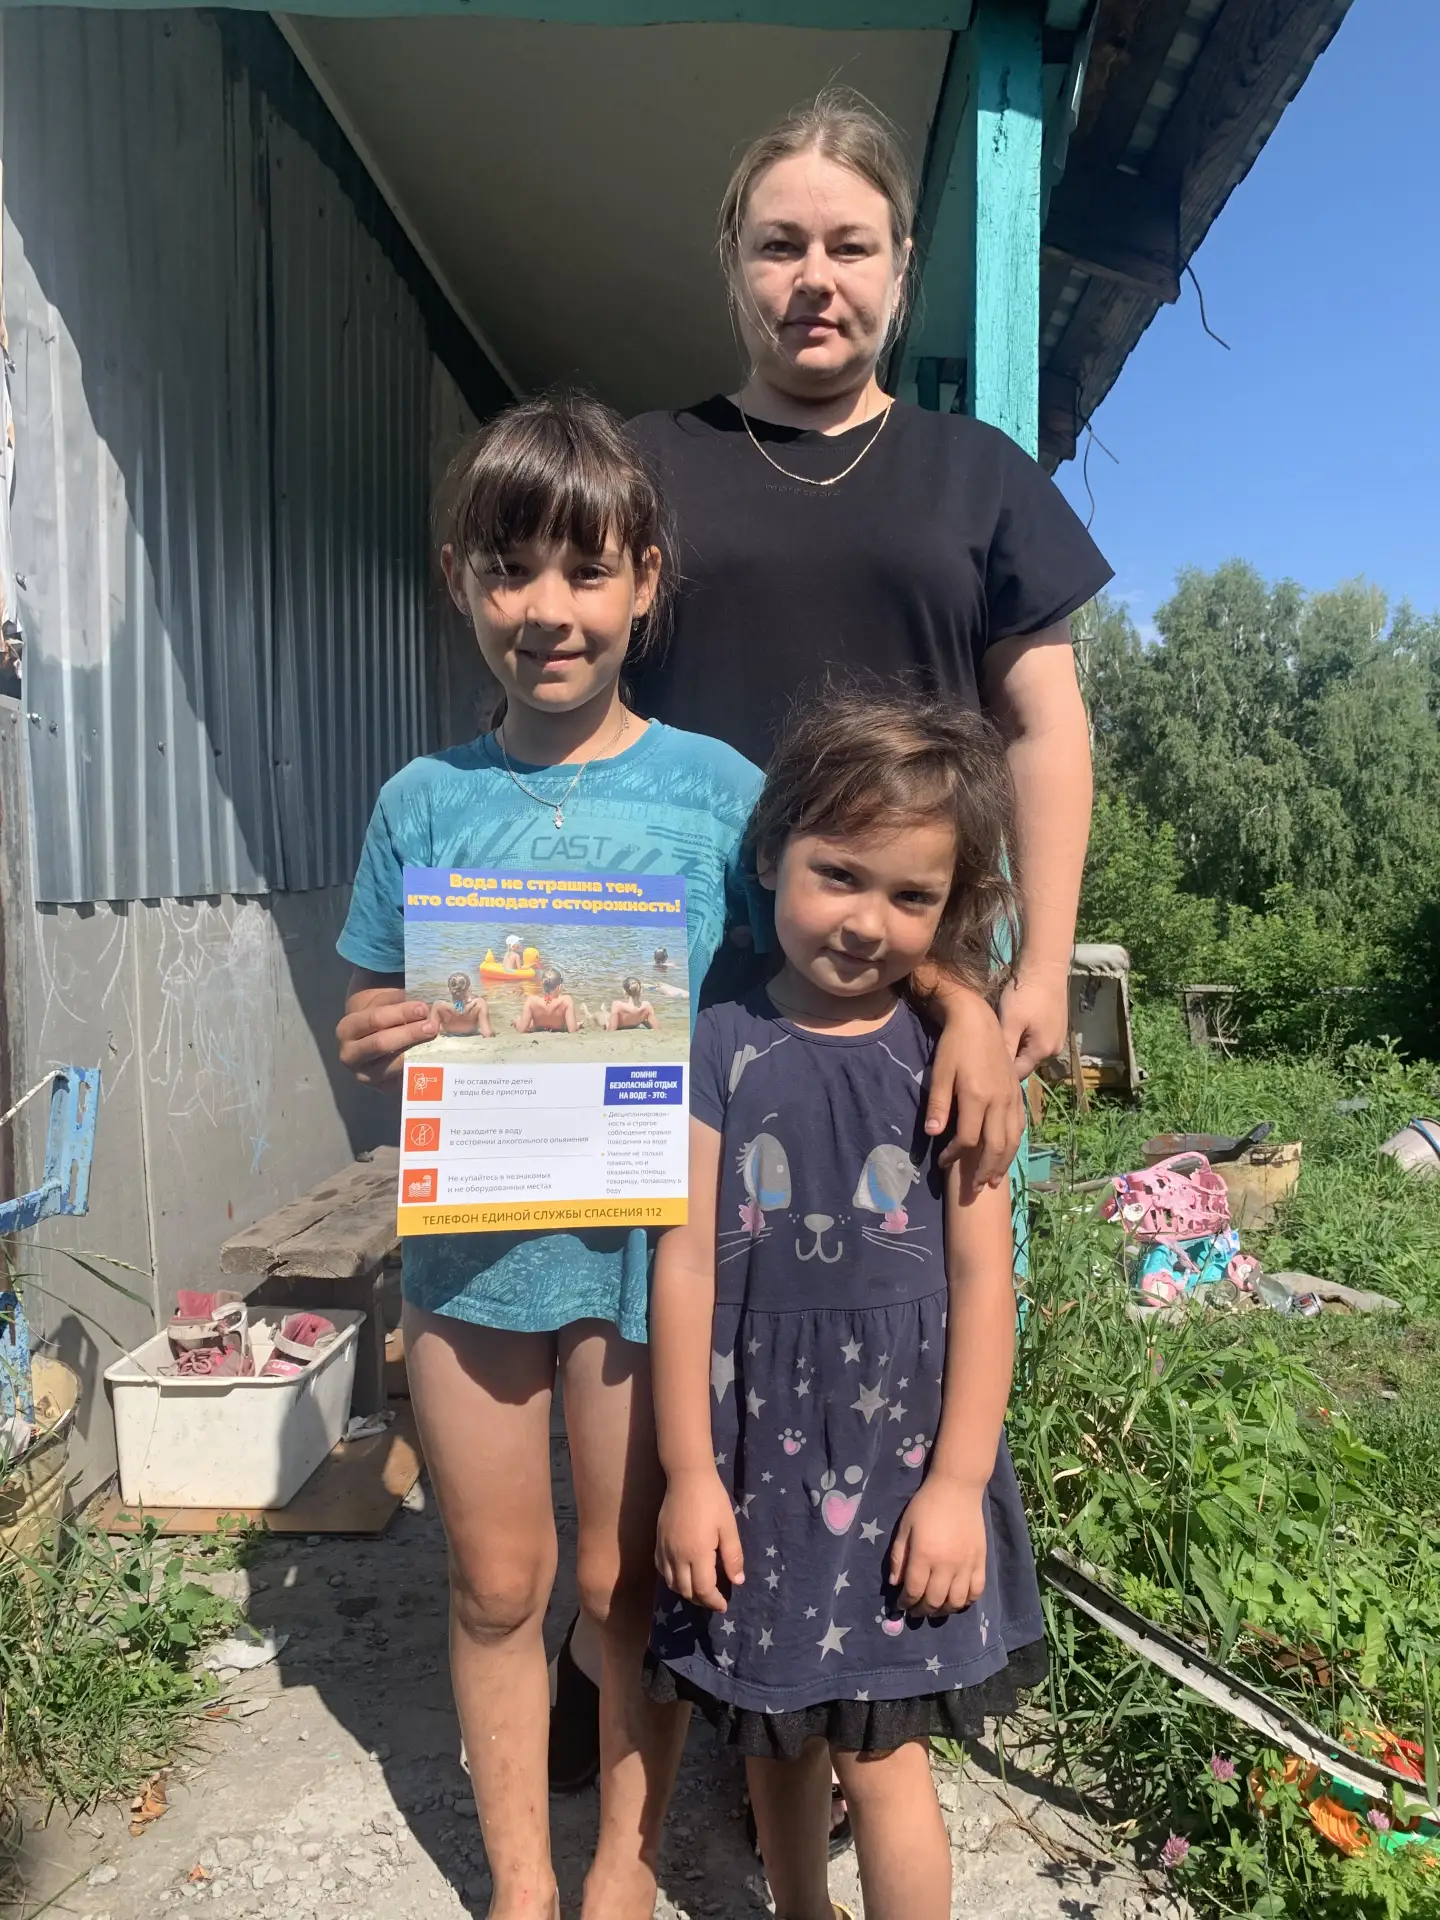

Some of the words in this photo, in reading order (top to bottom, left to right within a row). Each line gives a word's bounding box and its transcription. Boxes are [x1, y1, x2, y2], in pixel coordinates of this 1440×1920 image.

[449, 873, 498, 891] Вода
[501, 878, 524, 891] не
[527, 879, 603, 895] страшна
[606, 881, 643, 897] тем,
[407, 894, 442, 907] кто
[445, 893, 548, 910] соблюдает
[552, 899, 681, 913] осторожность!
[630, 1071, 658, 1079] ПОМНИ!
[466, 1077, 510, 1085] оставляйте
[511, 1077, 533, 1086] детей
[609, 1080, 653, 1089] БЕЗОПАСНЫЙ
[654, 1081, 678, 1089] ОТДЫХ
[481, 1088, 495, 1096] без
[496, 1089, 537, 1097] присмотра
[629, 1091, 648, 1100] ВОДЕ
[652, 1091, 667, 1099] ЭТО:
[462, 1128, 497, 1136] заходите
[505, 1128, 523, 1136] воду
[497, 1137, 549, 1146] алкогольного
[549, 1136, 589, 1145] опьянения
[460, 1174, 498, 1183] купайтесь
[506, 1172, 551, 1180] незнакомых
[465, 1184, 525, 1193] оборудованных
[422, 1212, 479, 1226] ТЕЛЕФОН
[481, 1208, 531, 1223] ЕДИНОЙ
[533, 1208, 582, 1222] СЛУЖБЫ
[584, 1207, 643, 1220] СПАСЕНИЯ
[645, 1207, 662, 1218] 112
